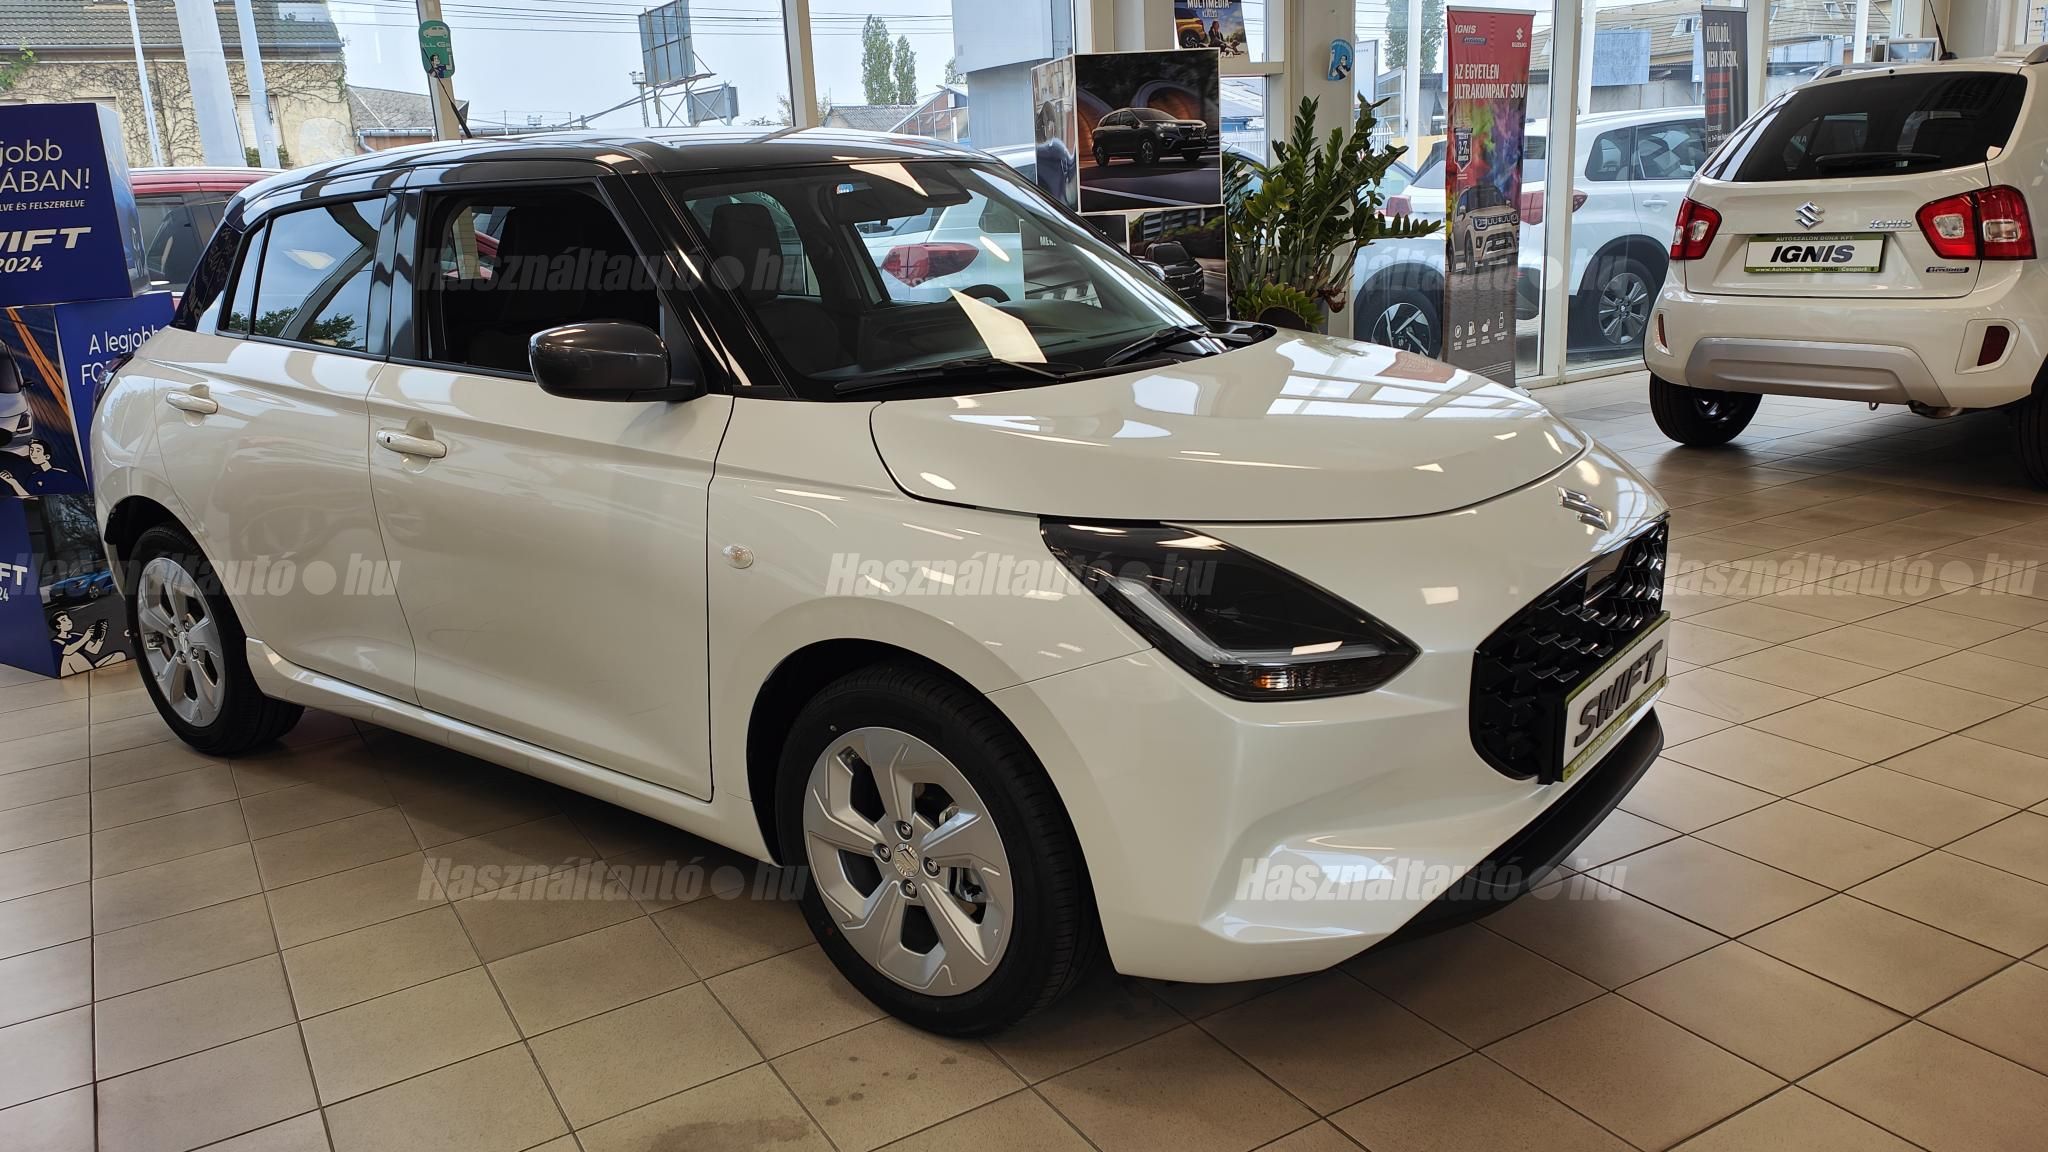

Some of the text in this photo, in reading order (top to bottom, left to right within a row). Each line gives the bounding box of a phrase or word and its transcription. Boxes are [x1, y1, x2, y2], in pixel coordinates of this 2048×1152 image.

[1455, 24, 1477, 34] IGNIS
[1454, 64, 1500, 79] AZ EGYETLEN
[1454, 83, 1526, 99] ULTRAKOMPAKT SUV
[16, 201, 27, 211] ÉS
[29, 199, 86, 210] FELSZERELVE
[1869, 218, 1913, 230] IGNIS
[0, 226, 92, 253] IFT
[1770, 245, 1855, 263] IGNIS
[89, 334, 101, 355] A
[1574, 639, 1664, 748] SWIFT
